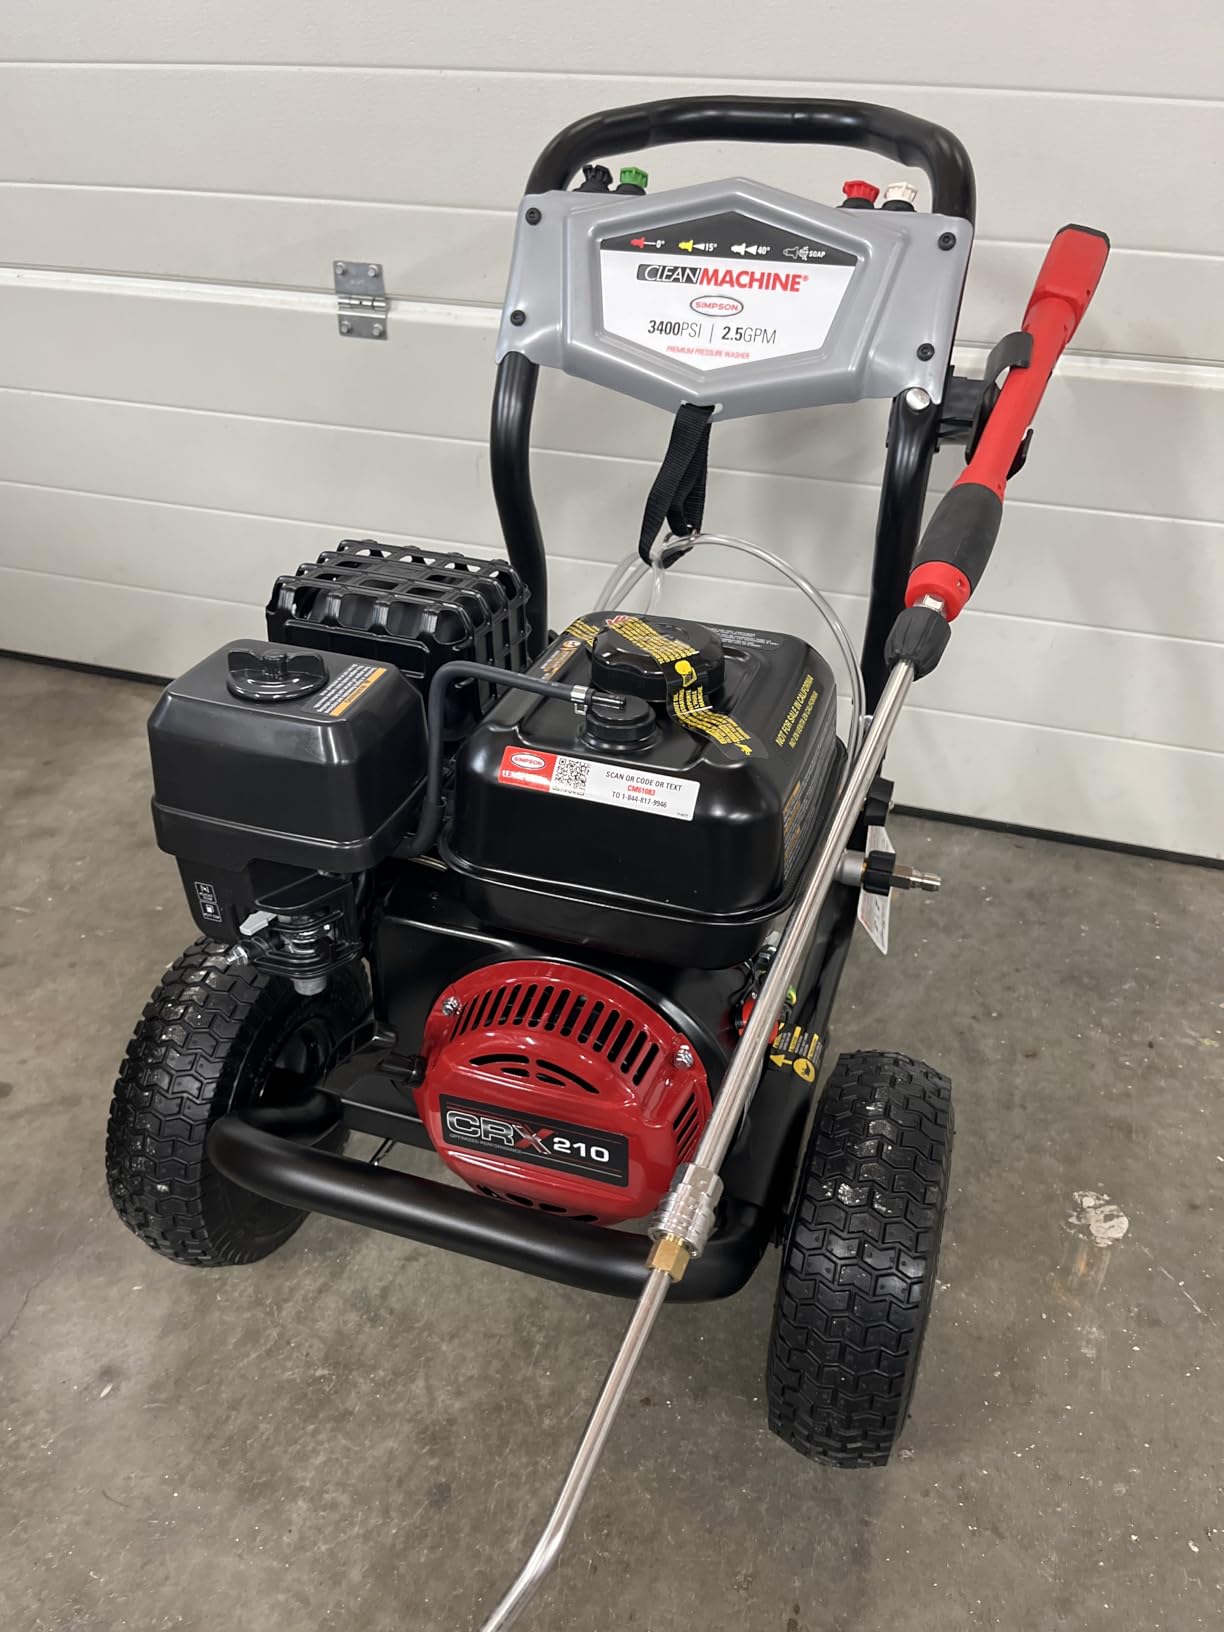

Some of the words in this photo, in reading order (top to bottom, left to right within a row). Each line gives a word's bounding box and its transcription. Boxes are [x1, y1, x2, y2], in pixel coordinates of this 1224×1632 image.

[808, 249, 826, 259] SOAP
[695, 301, 739, 312] SIMPSON
[648, 320, 702, 338] 3400PSI
[721, 326, 777, 344] 2.5GPM
[787, 706, 800, 724] SALE
[781, 719, 793, 735] FOR
[776, 730, 787, 747] NOT
[605, 770, 625, 781] SCAN
[635, 776, 654, 786] CODE
[654, 779, 665, 788] OR
[666, 782, 683, 791] TEXT
[612, 791, 621, 799] TO
[622, 792, 668, 808] 1-844-817-9946
[446, 1110, 554, 1155] CRX
[553, 1137, 610, 1162] 210
